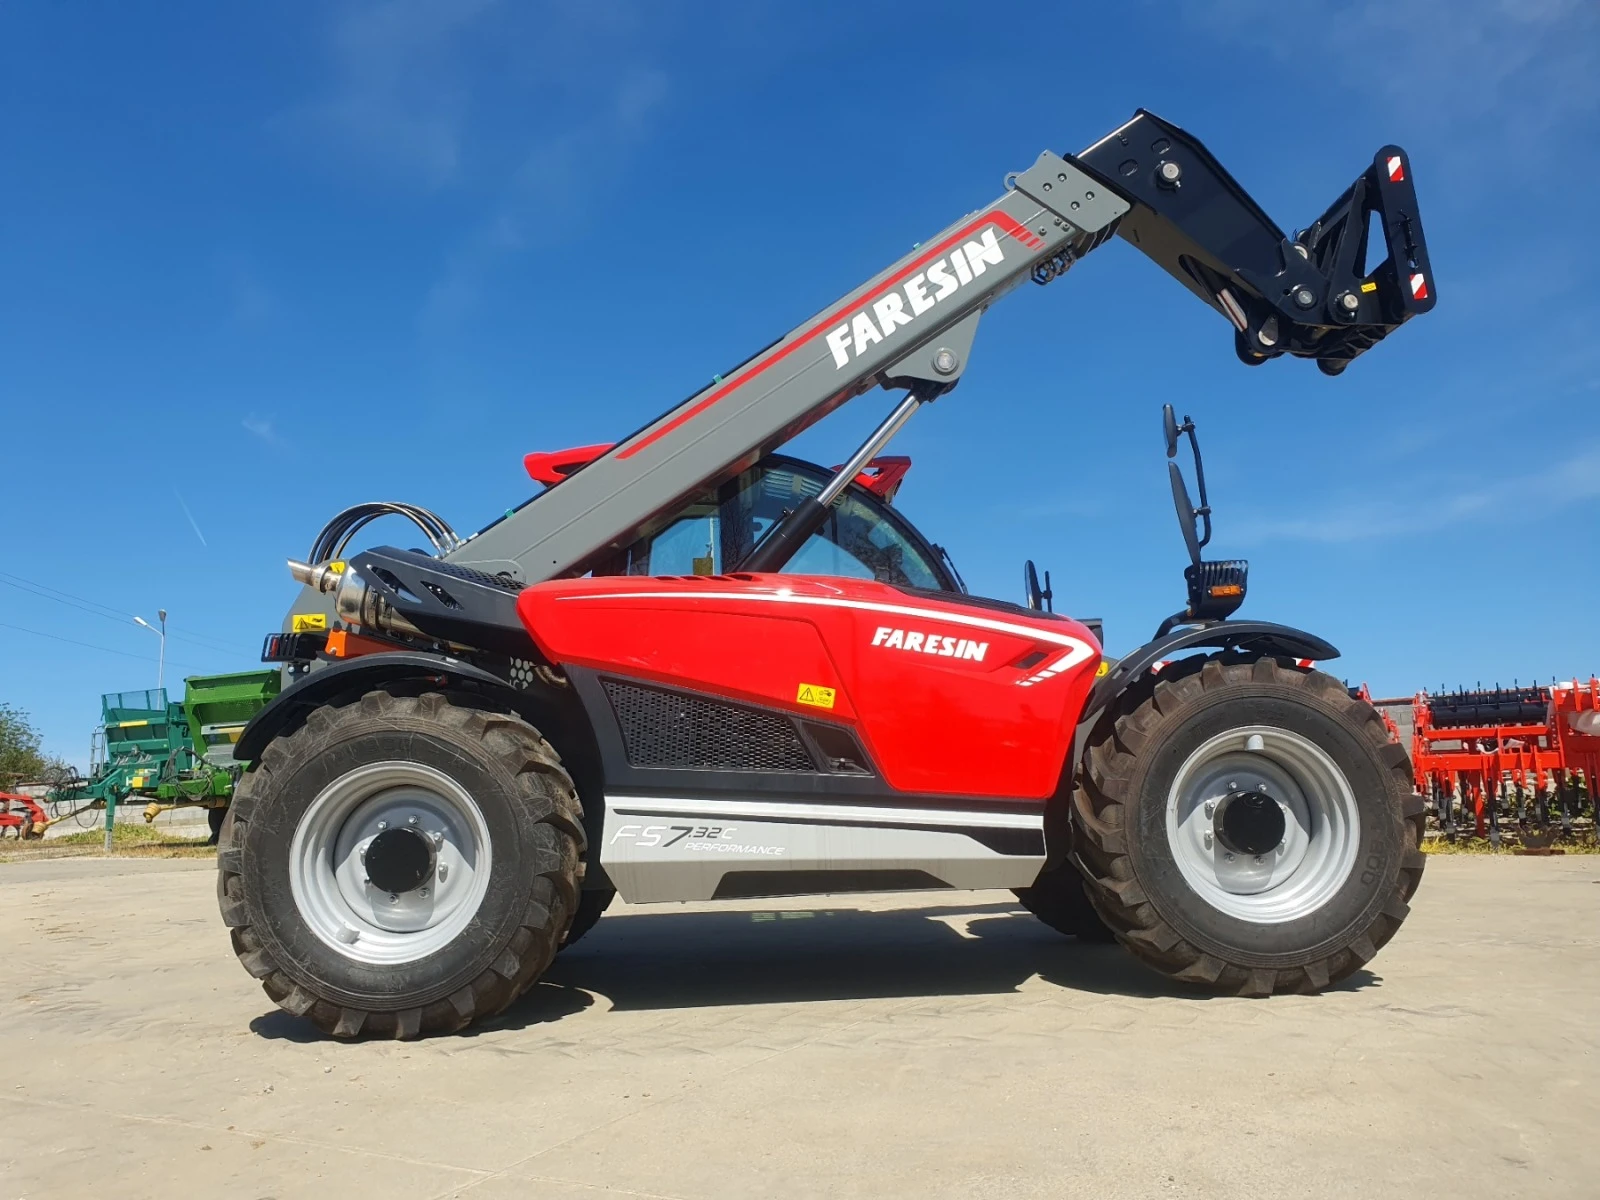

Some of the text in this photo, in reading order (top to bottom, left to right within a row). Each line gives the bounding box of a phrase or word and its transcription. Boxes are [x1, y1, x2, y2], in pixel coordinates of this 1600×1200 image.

[825, 226, 1005, 370] FARESIN
[871, 627, 990, 661] FARESIN
[684, 842, 786, 856] PERFORMANCE
